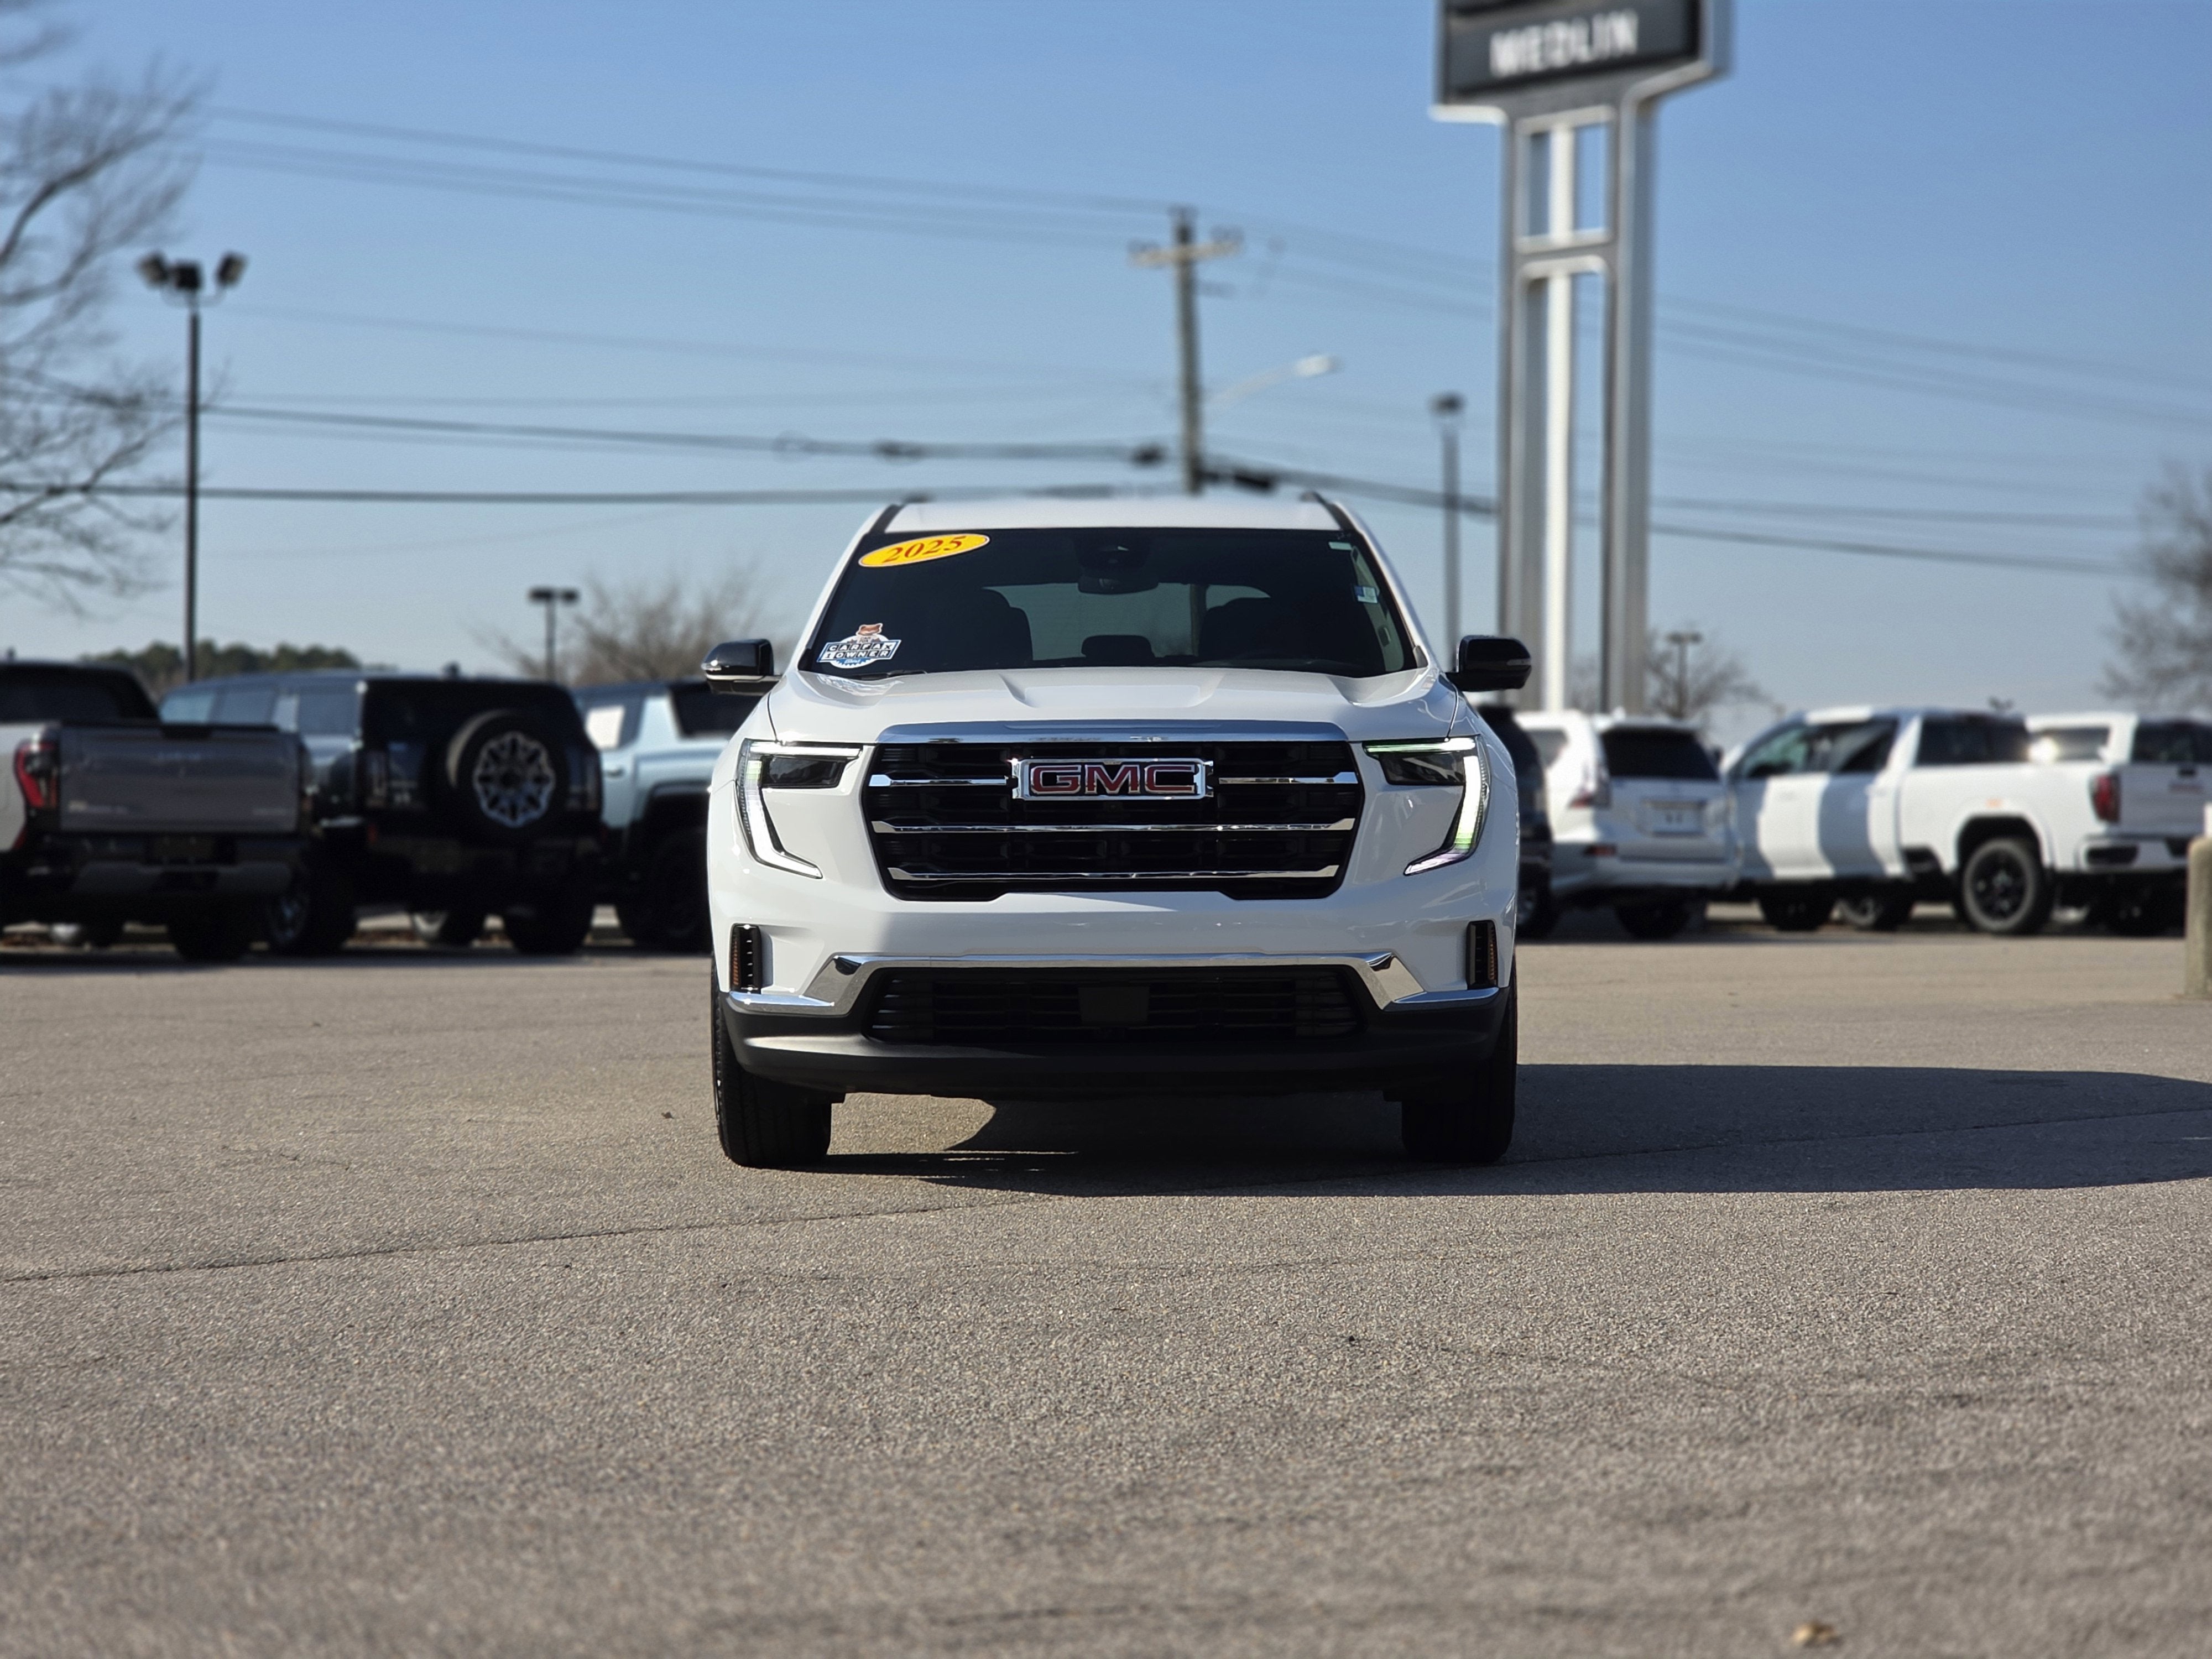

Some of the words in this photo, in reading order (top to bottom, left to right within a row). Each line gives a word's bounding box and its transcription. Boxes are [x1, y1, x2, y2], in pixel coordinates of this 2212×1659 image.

[1490, 9, 1638, 77] MEDLIN
[882, 536, 967, 563] 2025
[1031, 765, 1195, 794] GMC
